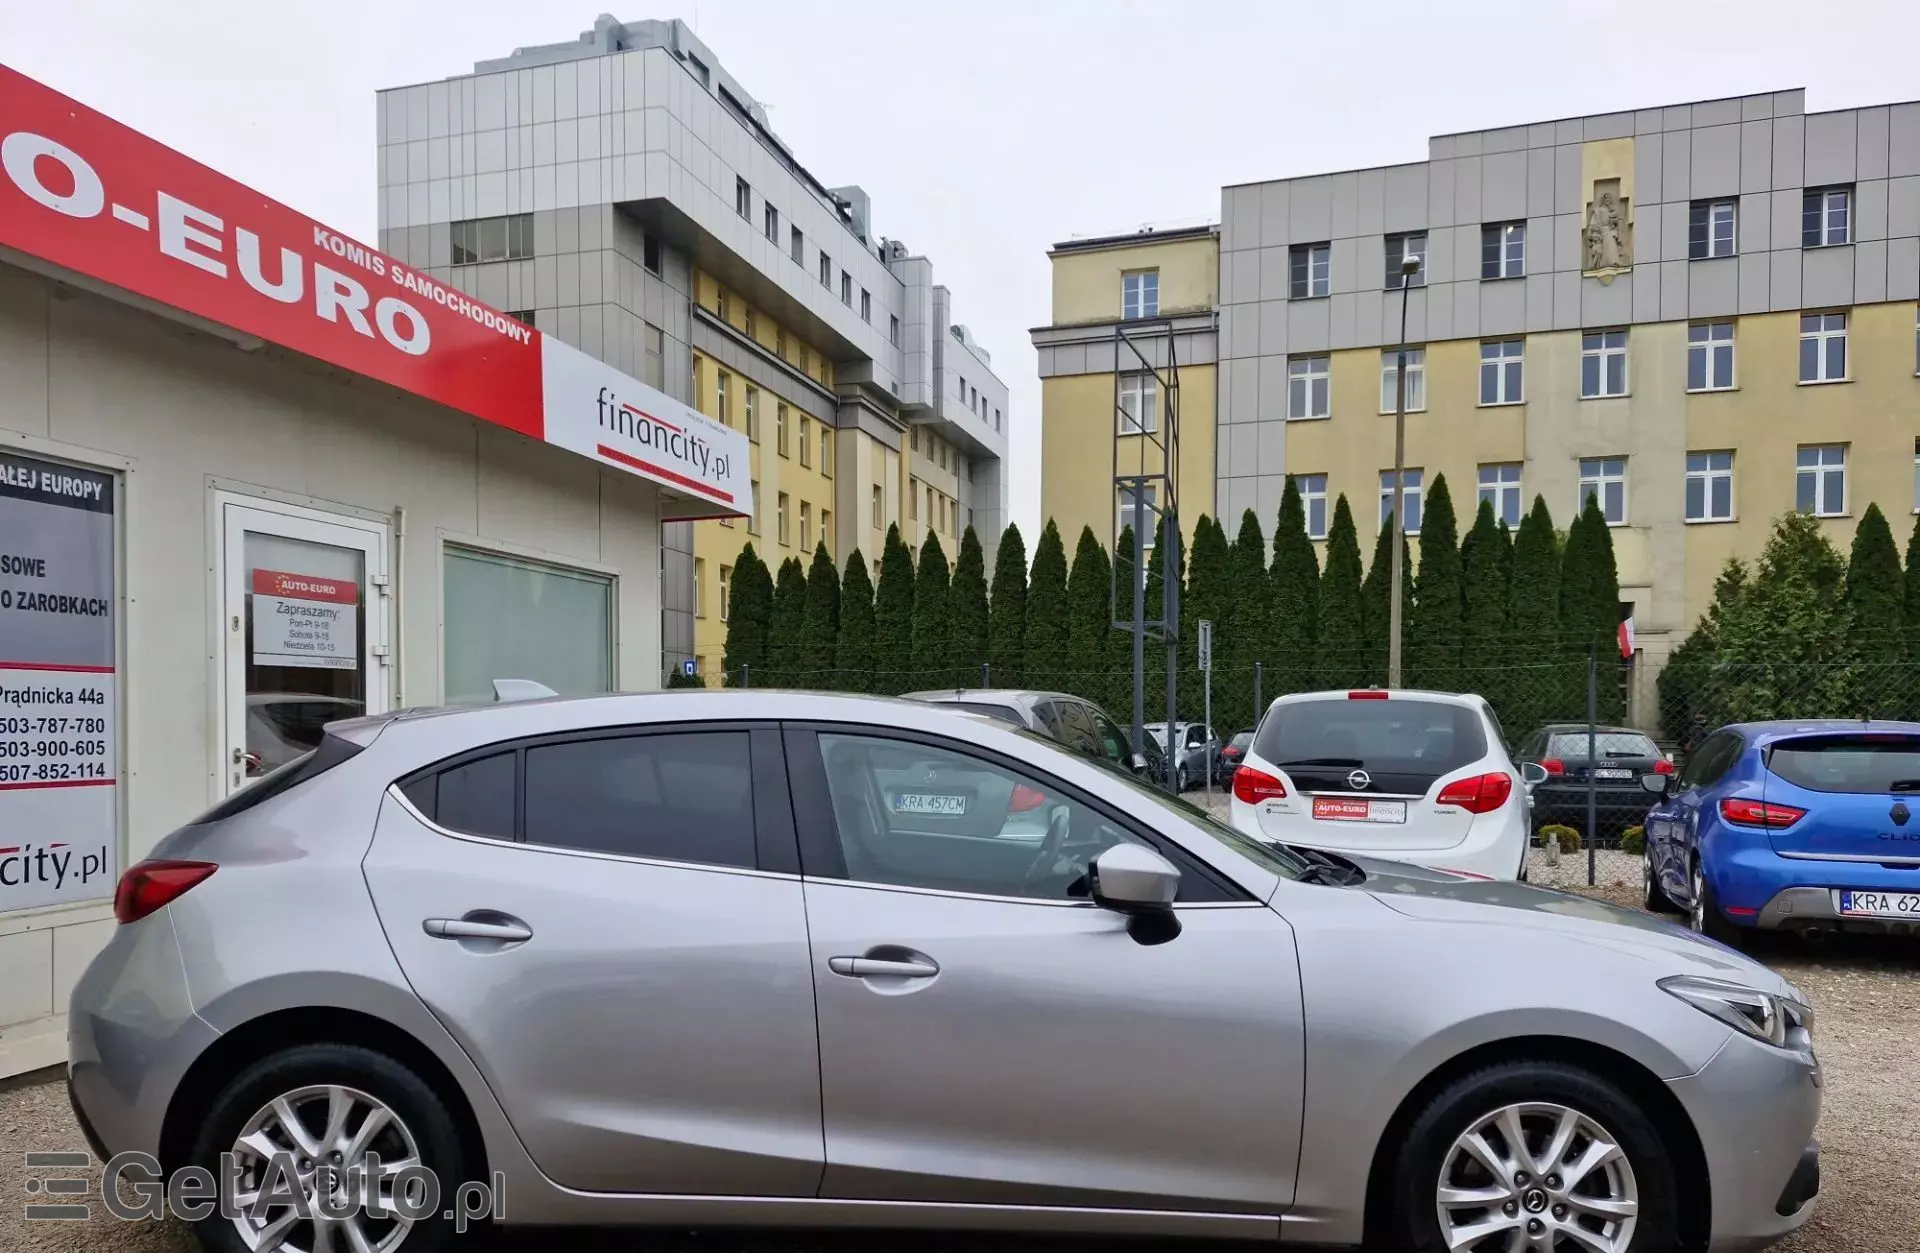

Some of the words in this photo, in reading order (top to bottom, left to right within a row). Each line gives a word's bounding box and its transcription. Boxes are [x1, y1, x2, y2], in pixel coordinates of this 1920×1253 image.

[1, 131, 431, 356] O-EURO
[313, 226, 386, 276] KOMIS
[391, 264, 532, 346] SAMOCHODOWY
[596, 386, 731, 481] financity.pl
[41, 472, 103, 501] EUROPY
[1, 554, 46, 578] SOWE
[281, 580, 336, 594] AUTO-EURO
[1, 590, 12, 609] O
[17, 591, 108, 617] ZAROBKACH
[289, 629, 313, 640] Sobota
[283, 640, 315, 651] Niedziela
[317, 643, 336, 652] 10-15
[78, 688, 104, 705] 44a
[0, 717, 105, 734] 503-787-780
[0, 740, 105, 757] 503-900-605
[0, 763, 105, 781] 507-852-114
[901, 794, 923, 808] KRA
[927, 796, 964, 810] 457CM
[1318, 803, 1367, 813] AUTO-EURO
[0, 843, 107, 890] city.pl
[1853, 893, 1890, 911] KRA
[1897, 895, 1920, 913] 62
